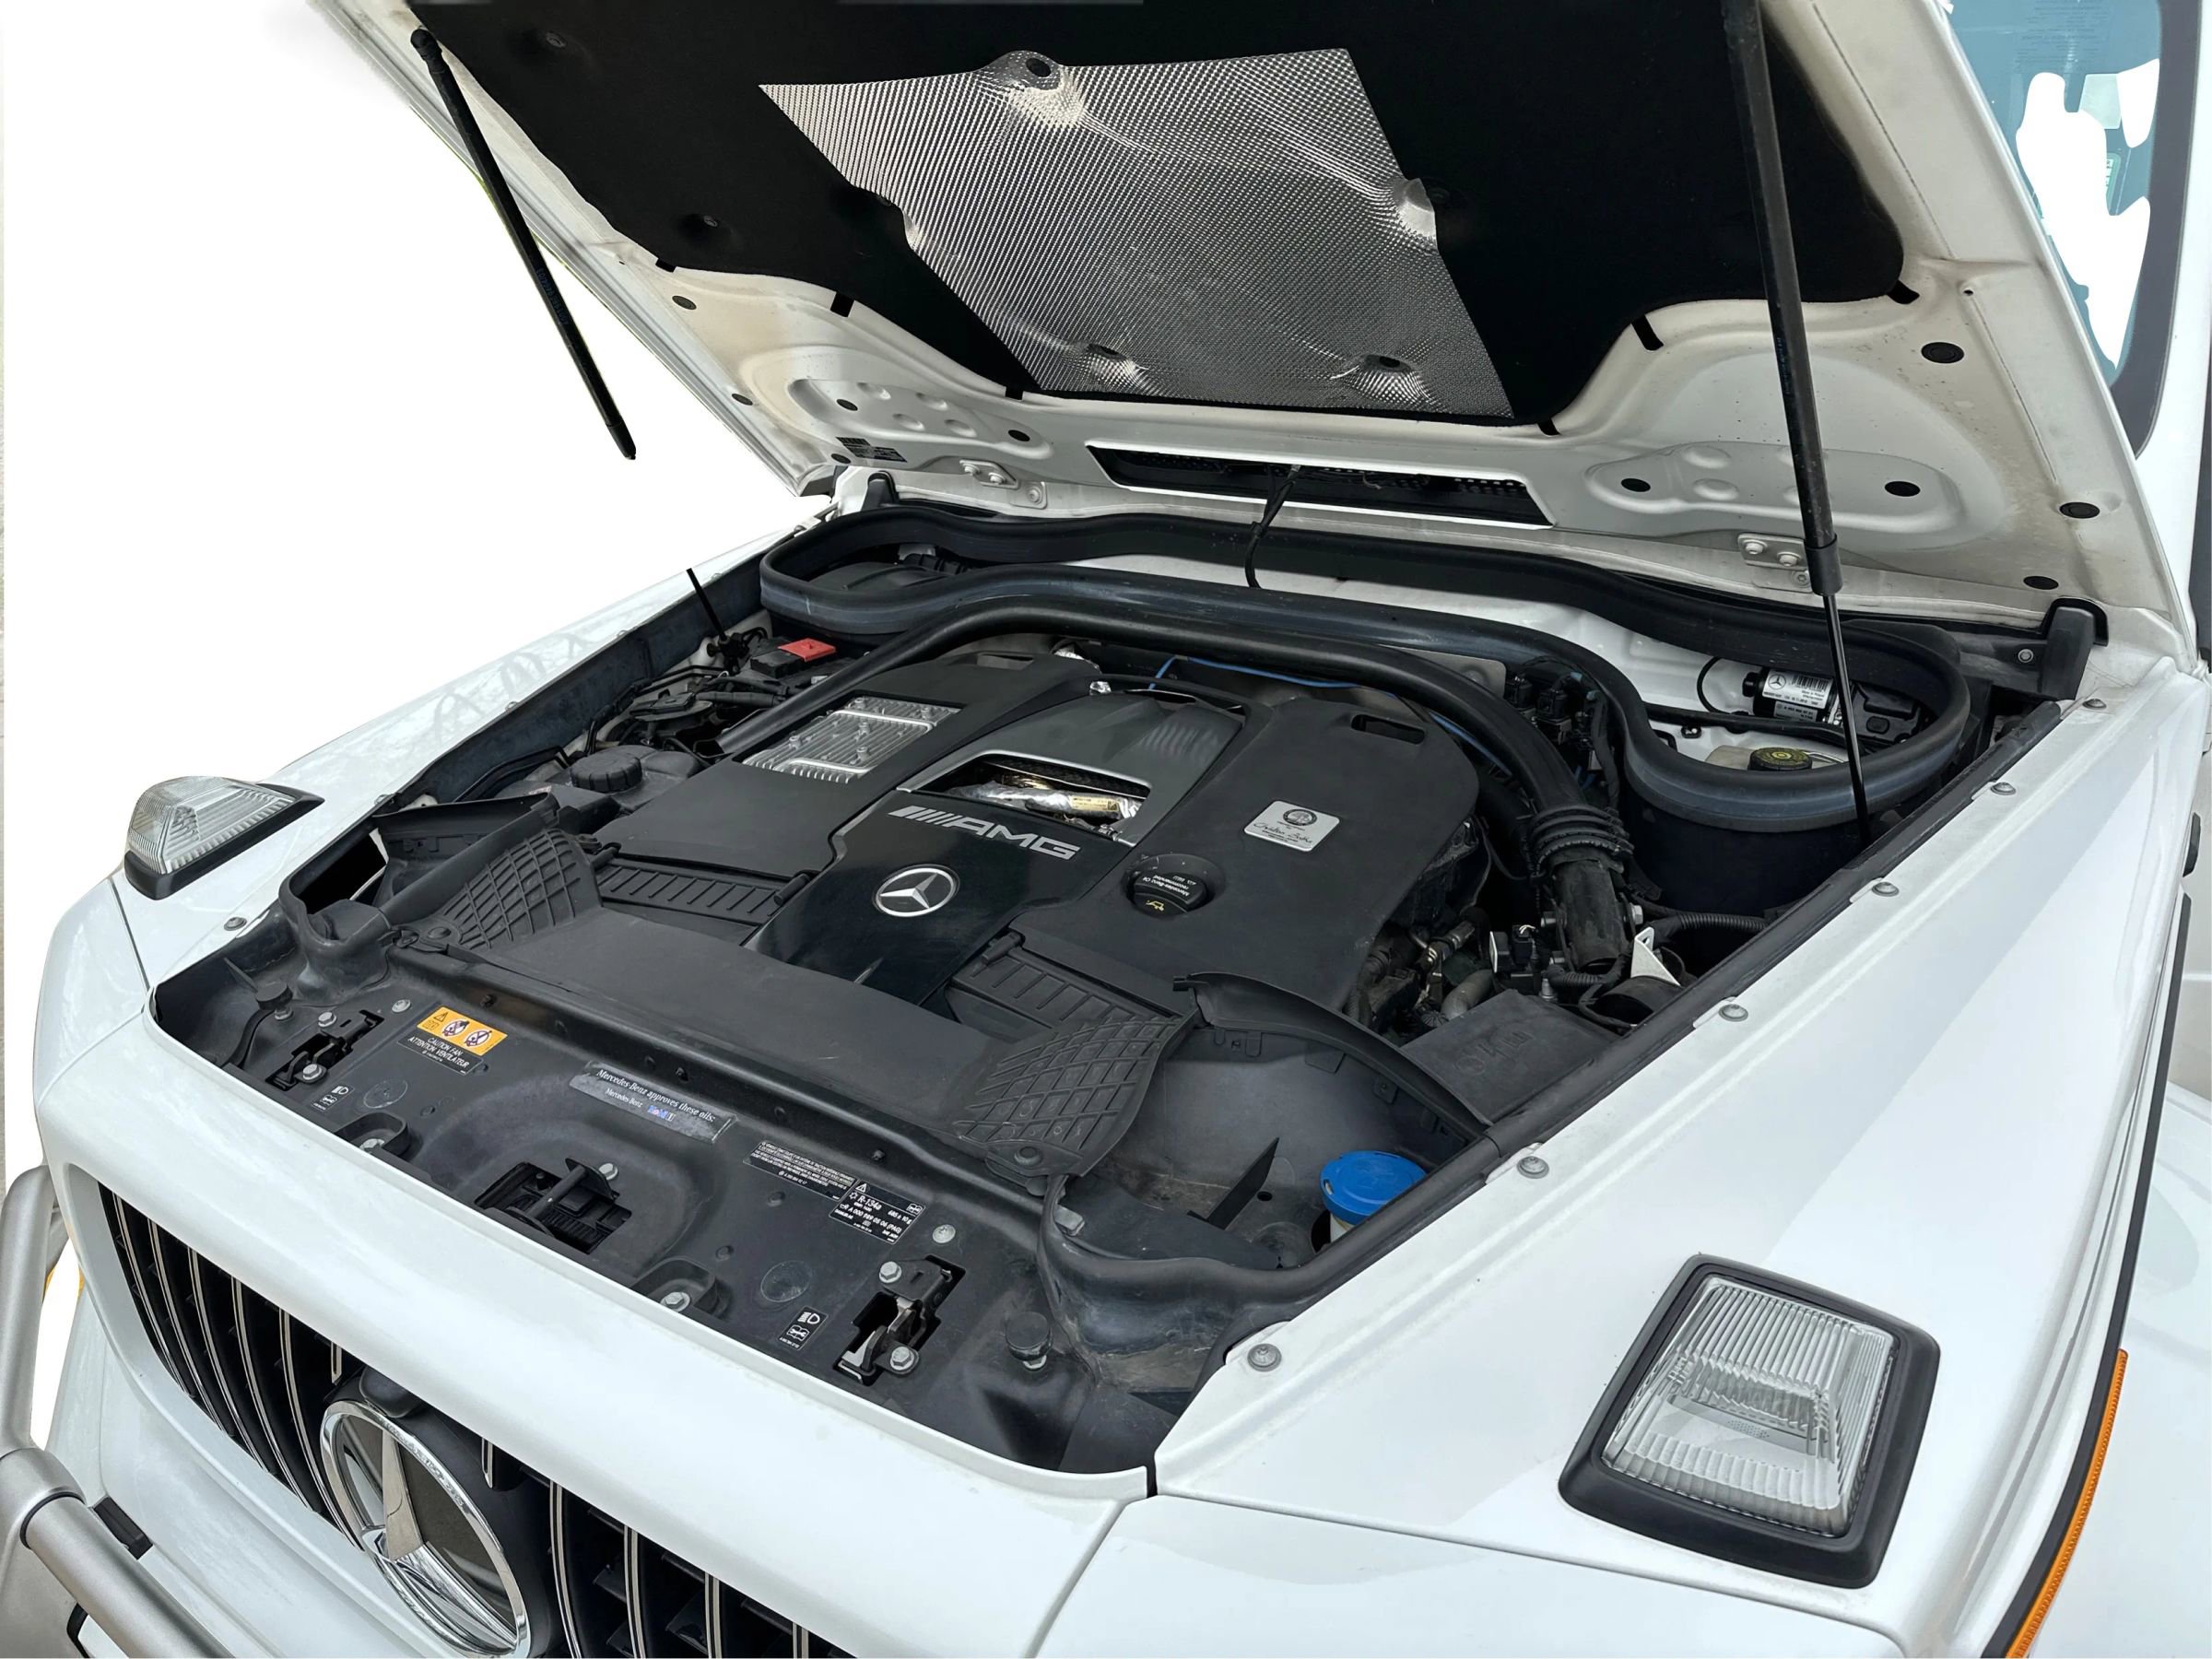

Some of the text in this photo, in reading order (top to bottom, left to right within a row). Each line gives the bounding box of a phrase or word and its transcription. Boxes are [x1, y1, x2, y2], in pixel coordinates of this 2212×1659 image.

[942, 816, 1081, 861] AMG
[407, 1036, 437, 1053] ATTENTION
[435, 1048, 470, 1068] VENTILATEUR
[428, 1037, 452, 1052] CAUTION
[449, 1047, 464, 1056] FAN
[596, 1069, 716, 1123] Mercedes-Benz approves these oils:
[857, 1195, 882, 1210] R-134a
